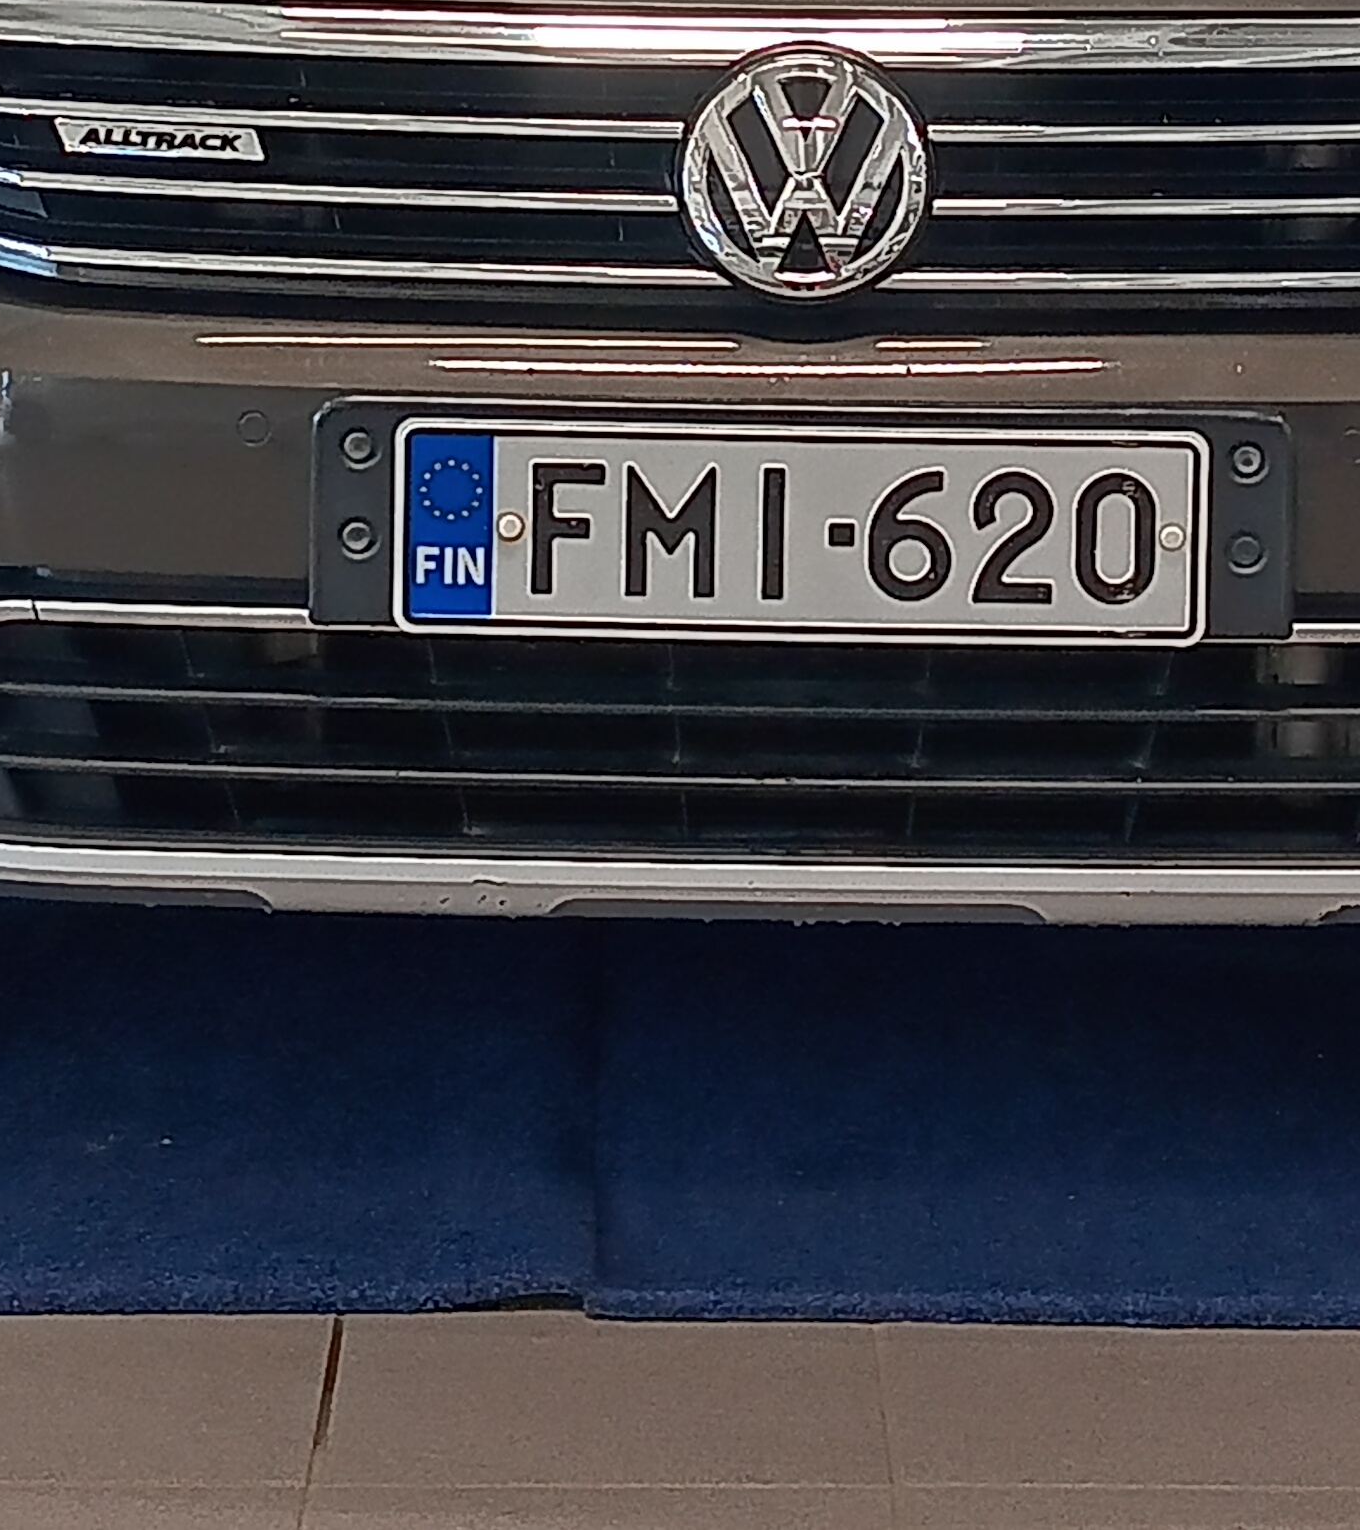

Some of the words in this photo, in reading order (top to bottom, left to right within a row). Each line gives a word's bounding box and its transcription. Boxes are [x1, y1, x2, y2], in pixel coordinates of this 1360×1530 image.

[79, 127, 242, 152] ALLTRACK
[530, 460, 1159, 606] FMI-620
[415, 545, 486, 586] FIN
